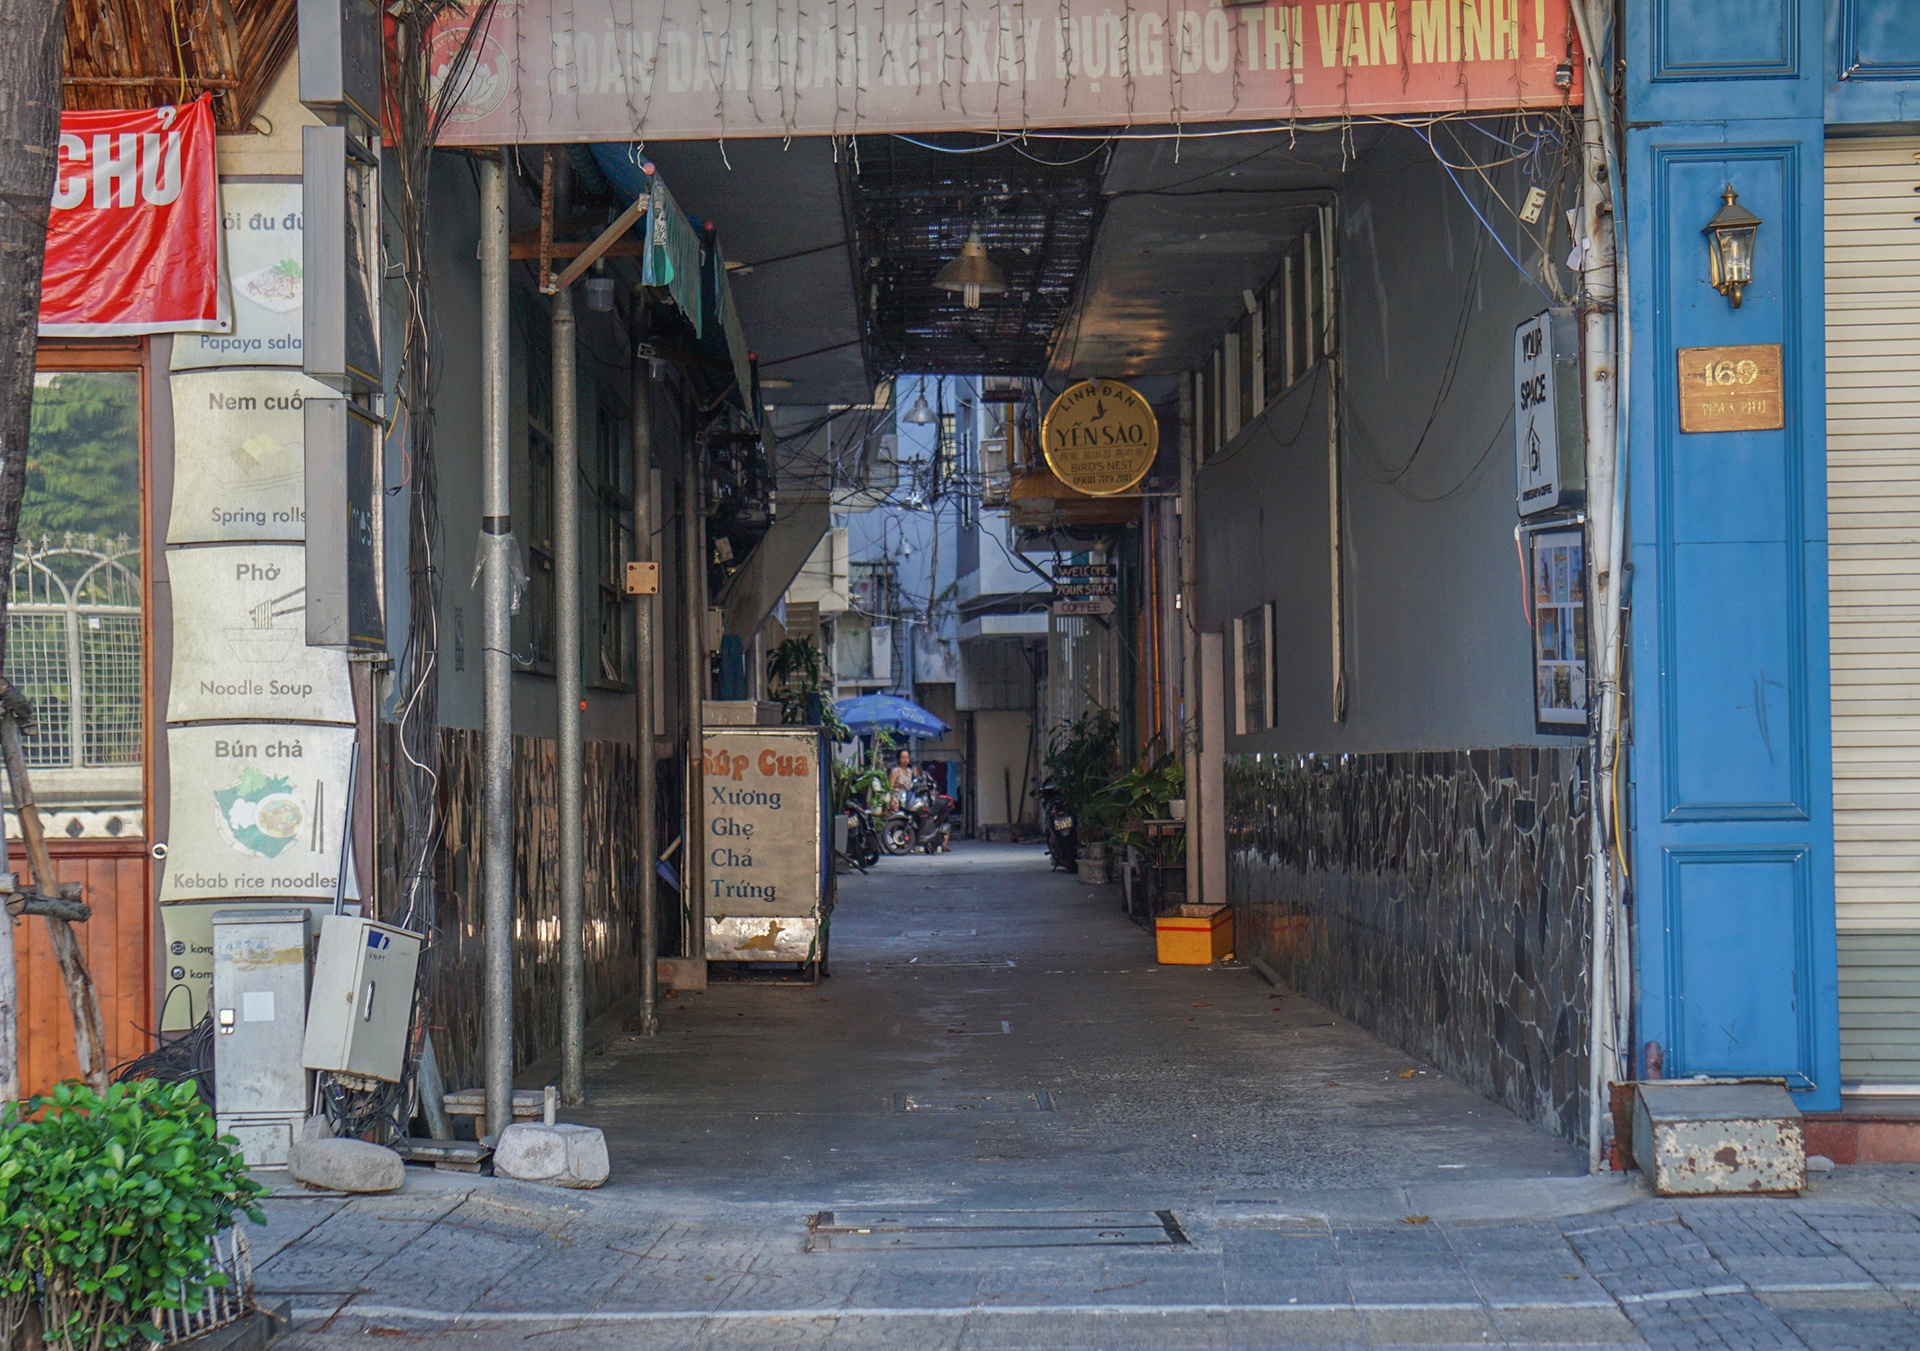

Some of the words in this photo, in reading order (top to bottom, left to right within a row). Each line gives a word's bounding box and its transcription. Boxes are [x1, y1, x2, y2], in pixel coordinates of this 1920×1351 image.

[552, 18, 653, 95] TOÀN
[881, 3, 953, 86] KẾT
[964, 4, 1042, 84] XÂY
[1055, 8, 1165, 93] DỰNG
[1242, 5, 1304, 85] THỊ
[1411, 0, 1519, 64] MINH
[51, 106, 183, 211] CHỦ
[248, 212, 275, 231] đu
[200, 334, 261, 353] Papaya
[267, 333, 303, 350] sala
[1522, 327, 1543, 363] YOUR
[1705, 360, 1758, 387] 169
[209, 392, 257, 410] Nem
[264, 388, 314, 411] cuố
[1060, 385, 1097, 412] LINH
[1102, 386, 1136, 408] ĐAN
[1521, 373, 1546, 411] SPACE
[1071, 462, 1104, 473] BIRD'S
[1107, 460, 1134, 472] NEST
[211, 507, 266, 526] Spring
[272, 506, 306, 523] rolls
[236, 562, 281, 581] Phở
[1058, 565, 1109, 577] WELCOME
[1061, 602, 1101, 613] COFFEE
[200, 680, 264, 696] Noodle
[269, 680, 313, 699] Soup
[215, 739, 258, 758] Bún
[264, 738, 303, 758] chả
[703, 748, 749, 781] Súp
[758, 749, 810, 777] Cua
[711, 786, 782, 810] Xương
[711, 817, 754, 840] Ghẹ
[710, 847, 753, 867] Chả
[173, 873, 229, 889] Kebab
[234, 873, 265, 888] rice
[271, 872, 337, 889] noodles
[710, 879, 777, 902] Trứng
[369, 952, 386, 962] VNPT
